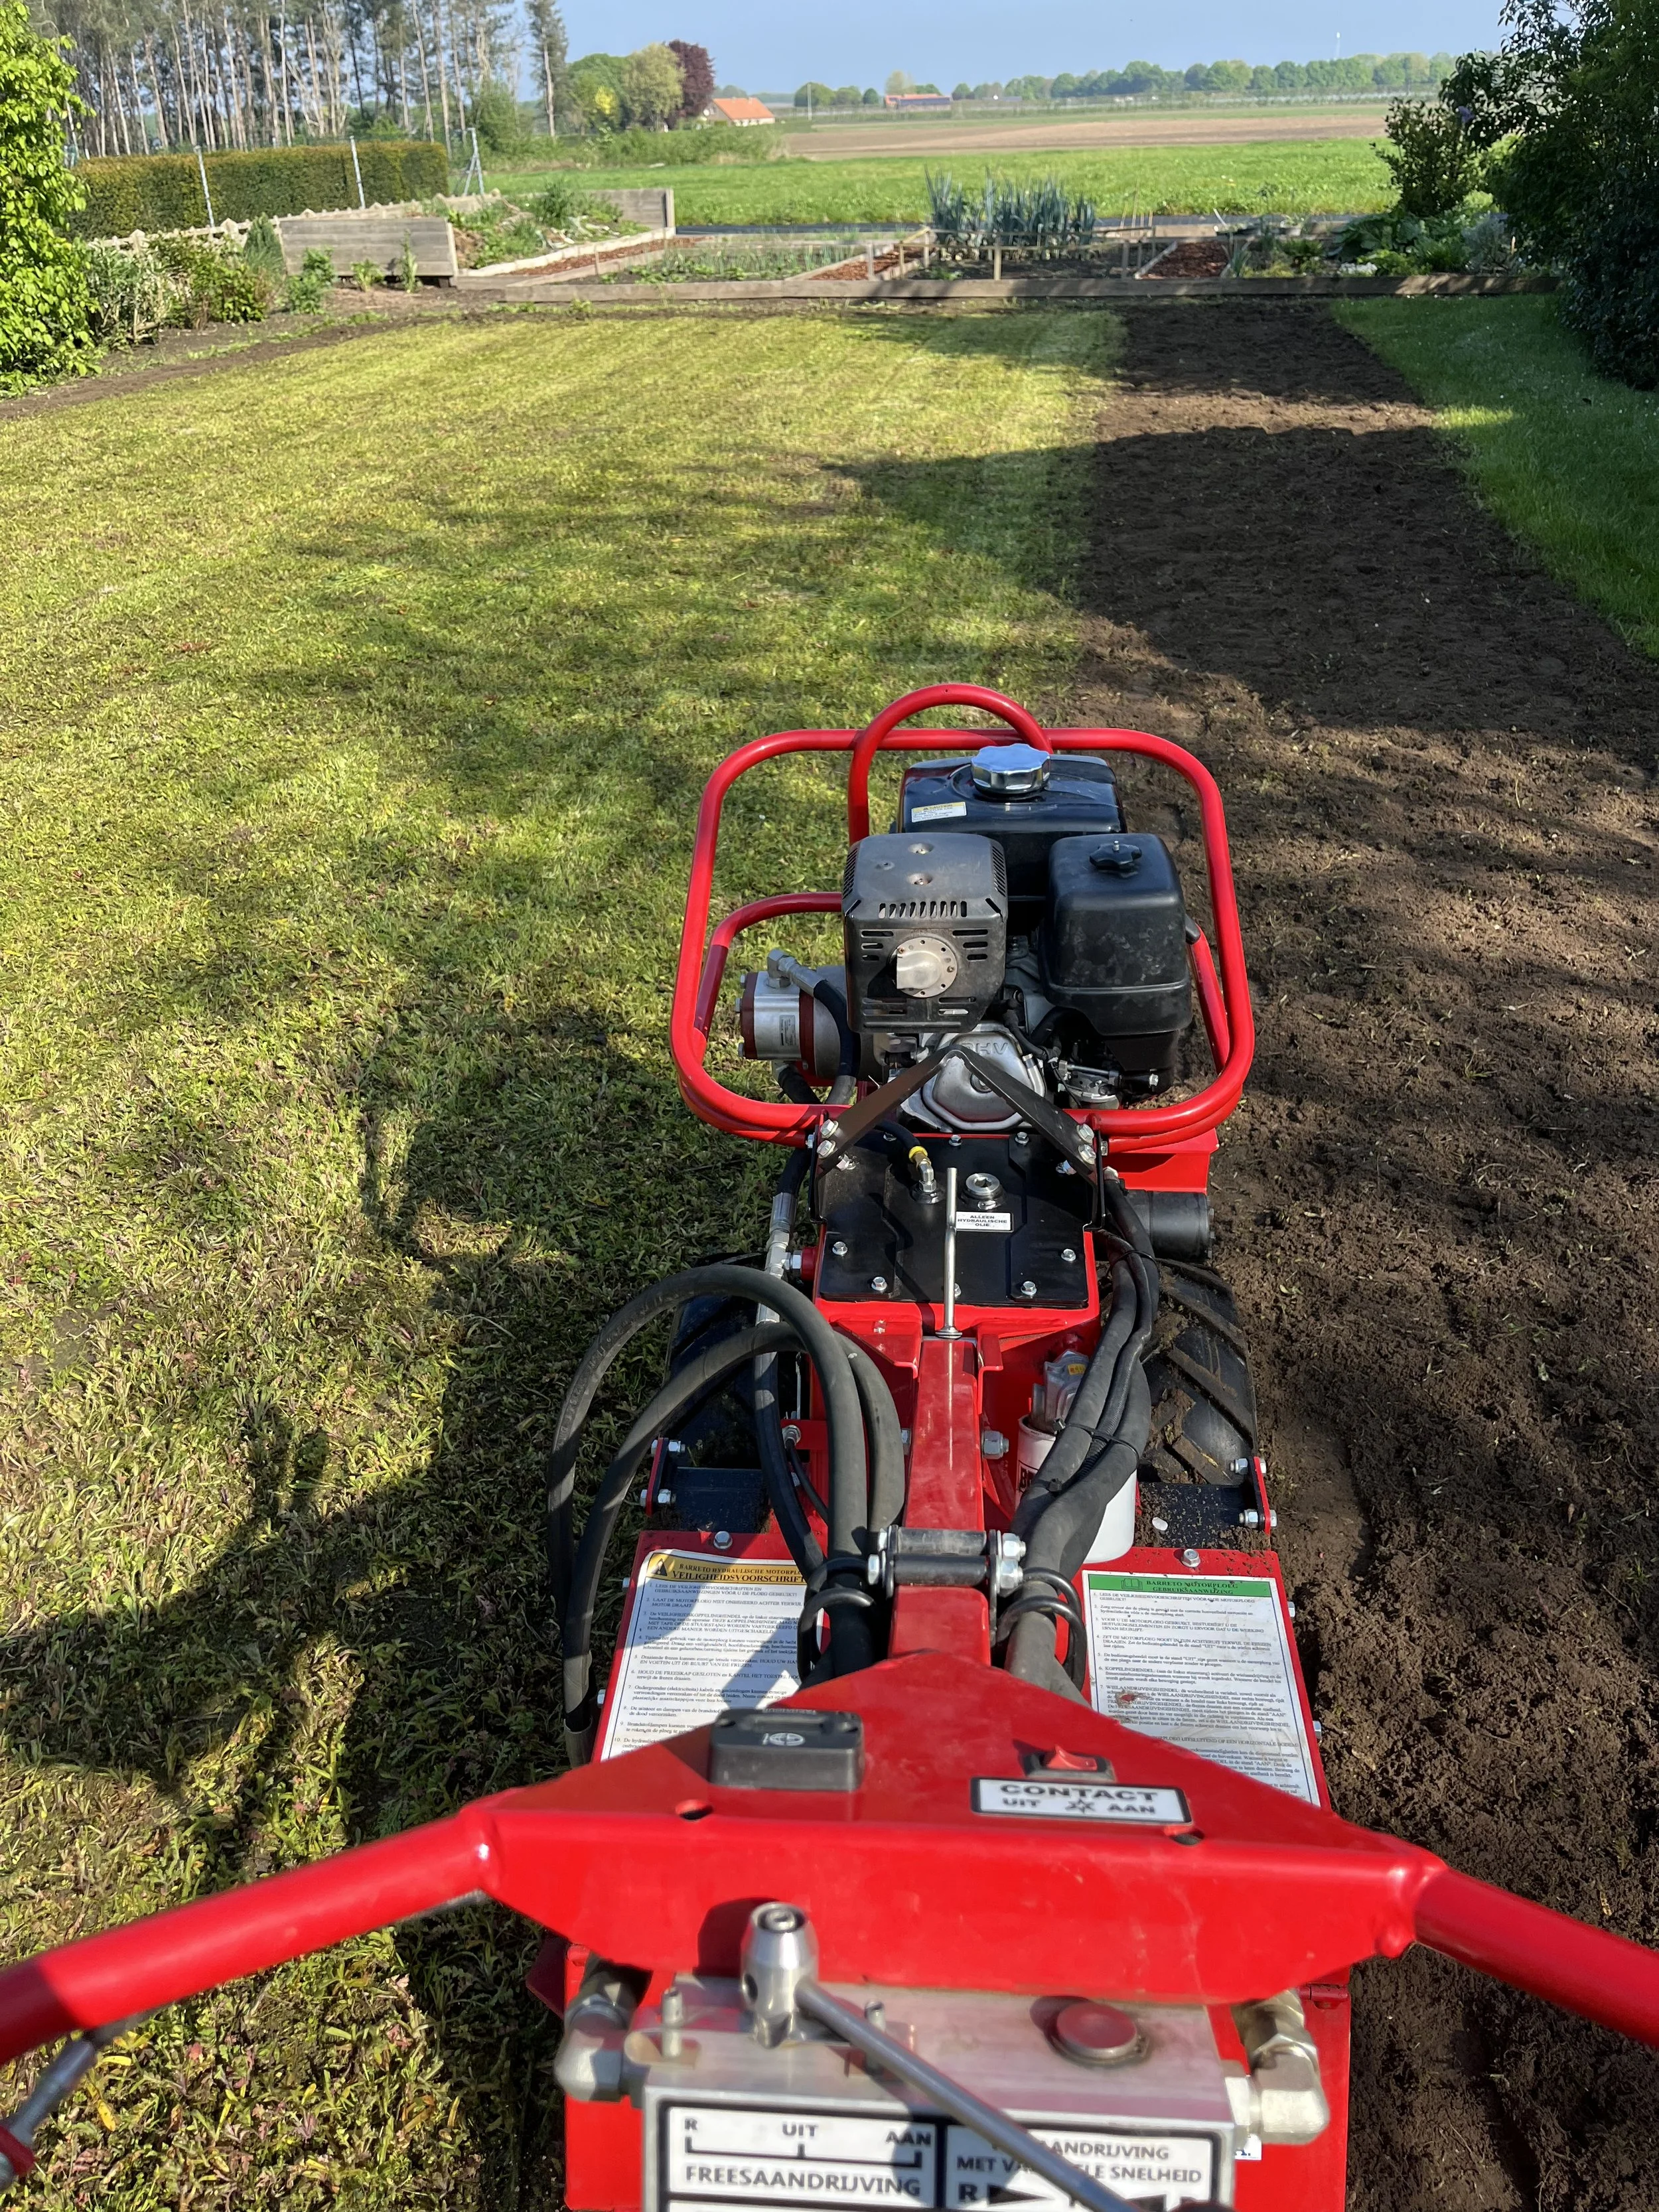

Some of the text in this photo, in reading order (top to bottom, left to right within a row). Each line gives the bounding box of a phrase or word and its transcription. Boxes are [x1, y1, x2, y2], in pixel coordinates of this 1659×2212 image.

[673, 1571, 804, 1583] VEILIGHEIDSVOORSCHRIFT
[680, 1564, 711, 1572] BARRETO
[1000, 1785, 1157, 1801] CONTACT
[1002, 1798, 1155, 1814] UIT AAN
[684, 2118, 931, 2146] R UIT AAN
[1040, 2140, 1168, 2160] ANDRIJVING
[957, 2156, 997, 2172] MET
[1111, 2166, 1201, 2183] SNELHEID
[685, 2165, 921, 2197] FREESAANDRIJVING
[958, 2182, 978, 2203] R
